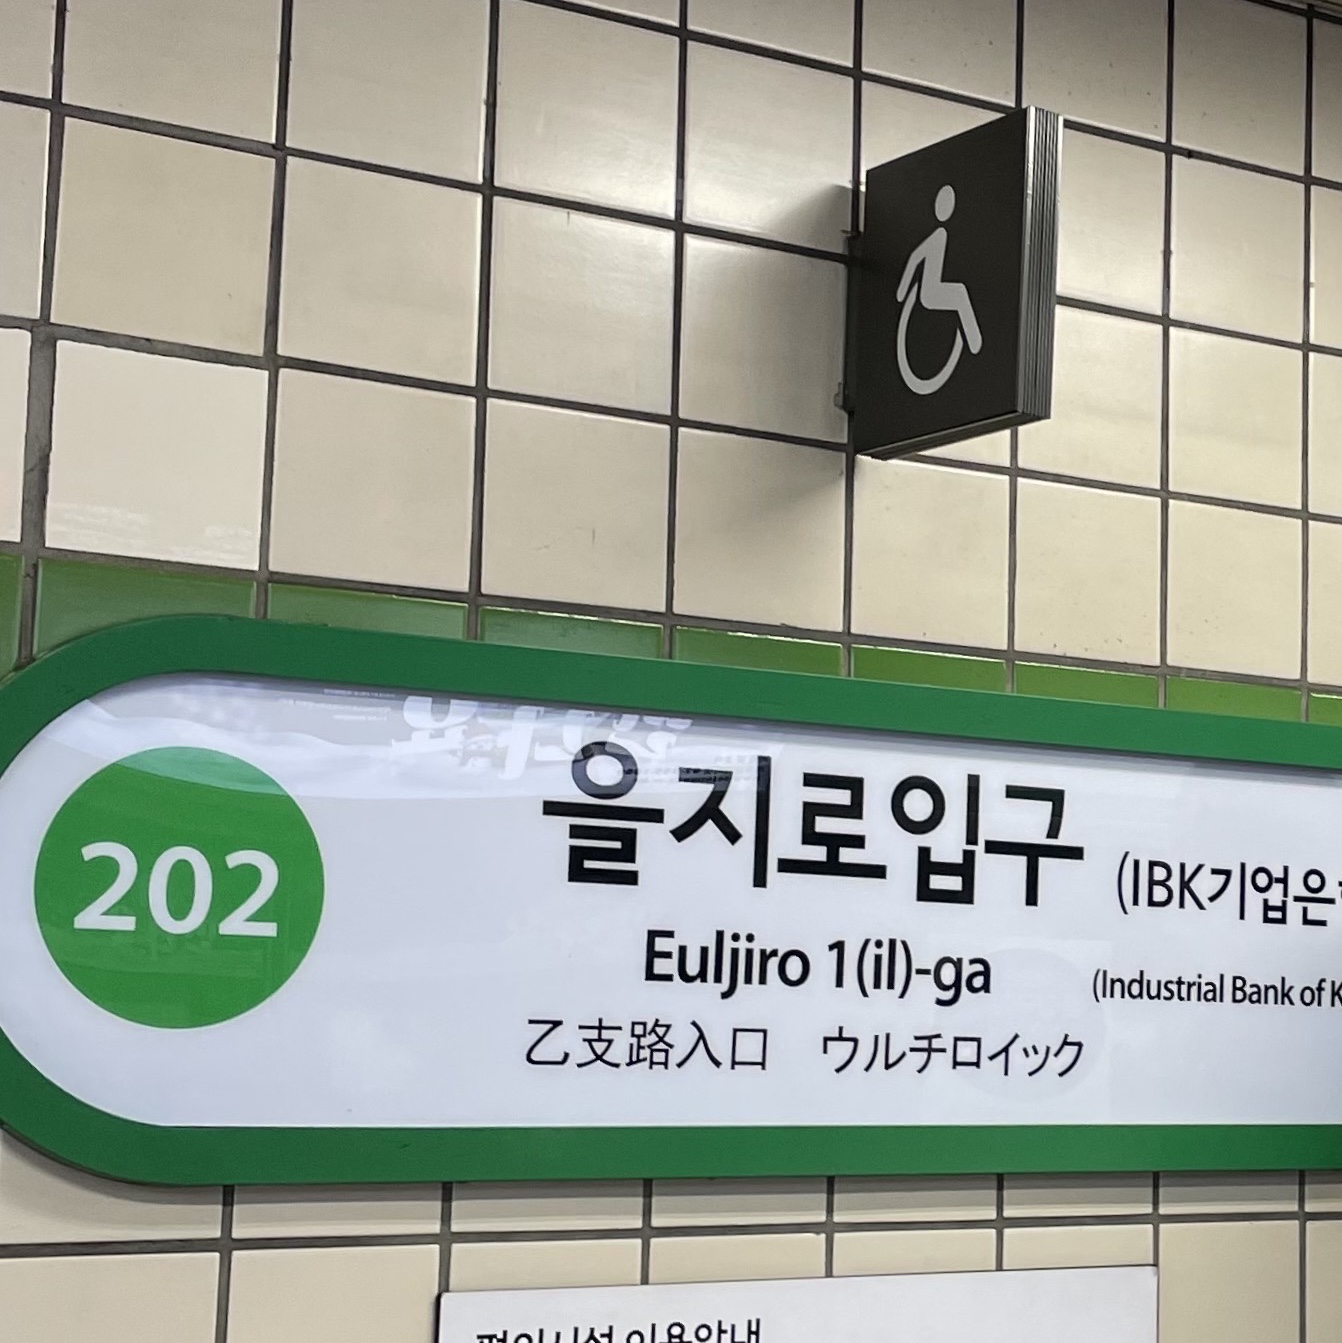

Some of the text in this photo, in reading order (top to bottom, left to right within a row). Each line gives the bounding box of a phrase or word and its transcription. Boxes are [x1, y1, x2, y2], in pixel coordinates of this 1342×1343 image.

[542, 740, 1085, 907] 을지로입구
[73, 842, 281, 937] 202
[643, 928, 993, 1006] Euljiro 1(il)-ga
[1091, 968, 1226, 1004] (Industrial
[1230, 974, 1295, 1006] Bank
[1299, 979, 1325, 1007] of
[525, 1016, 1086, 1079] 乙支路入口 ウルチロイック
